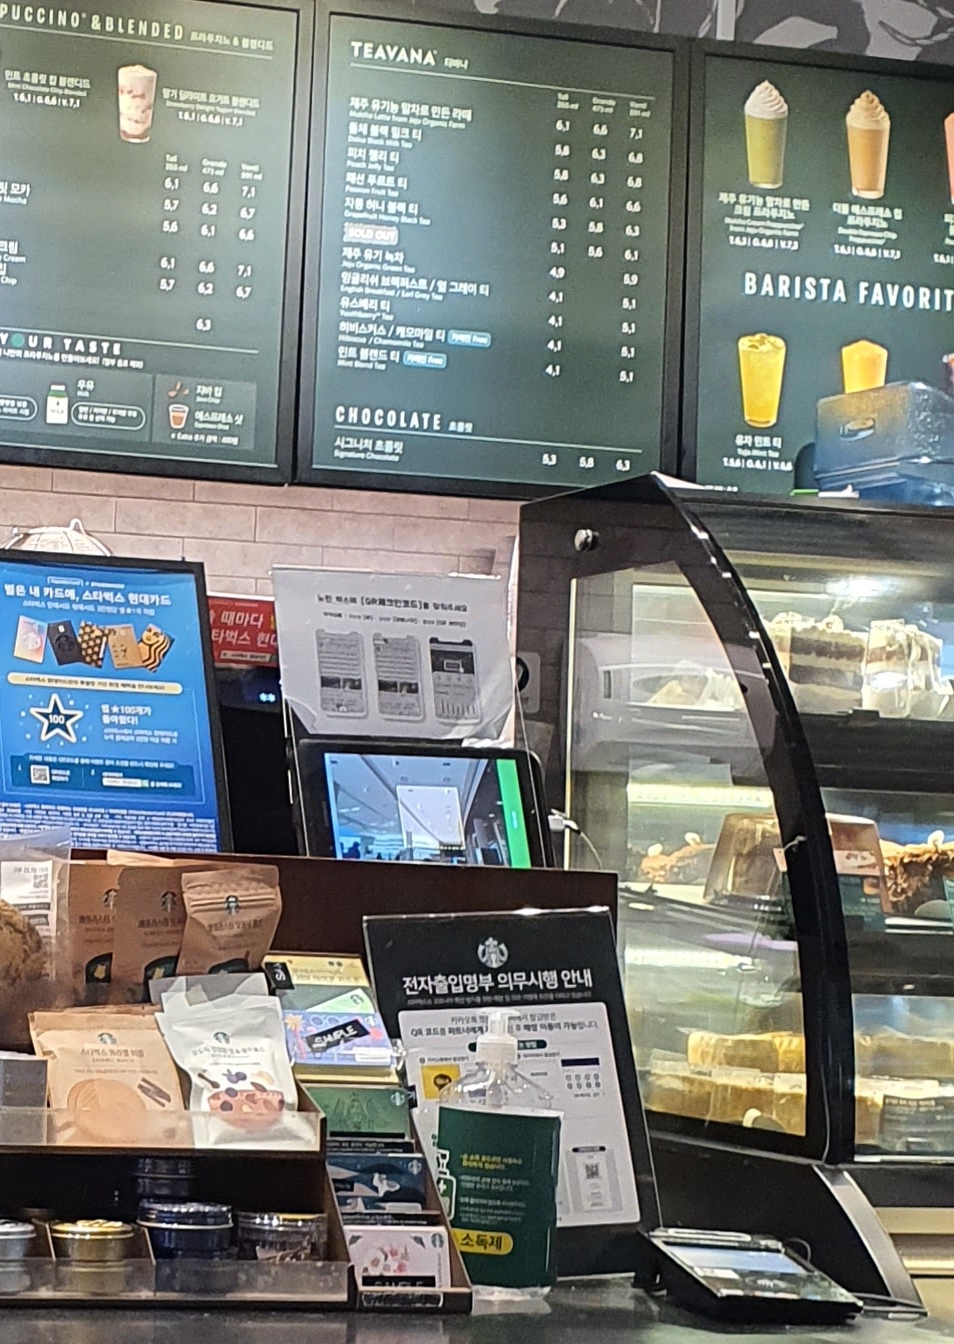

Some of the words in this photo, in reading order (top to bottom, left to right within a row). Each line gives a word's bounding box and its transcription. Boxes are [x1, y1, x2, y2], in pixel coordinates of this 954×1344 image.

[9, 182, 30, 196] 모카
[744, 272, 845, 301] BARISTA
[63, 338, 120, 355] TASTE
[335, 405, 440, 429] CHOCOLATE
[4, 583, 26, 597] 별은
[29, 586, 40, 597] 내
[43, 586, 79, 603] 카드에,
[82, 590, 125, 604] 스타벅스
[127, 593, 172, 606] 현대카드
[220, 610, 264, 629] 때마다
[48, 714, 65, 725] 100
[402, 974, 495, 996] 전자출입명부
[497, 970, 558, 992] 의무시행
[560, 968, 593, 988] 안내
[312, 1024, 358, 1048] SAMPLE
[460, 1233, 503, 1251] 소독제
